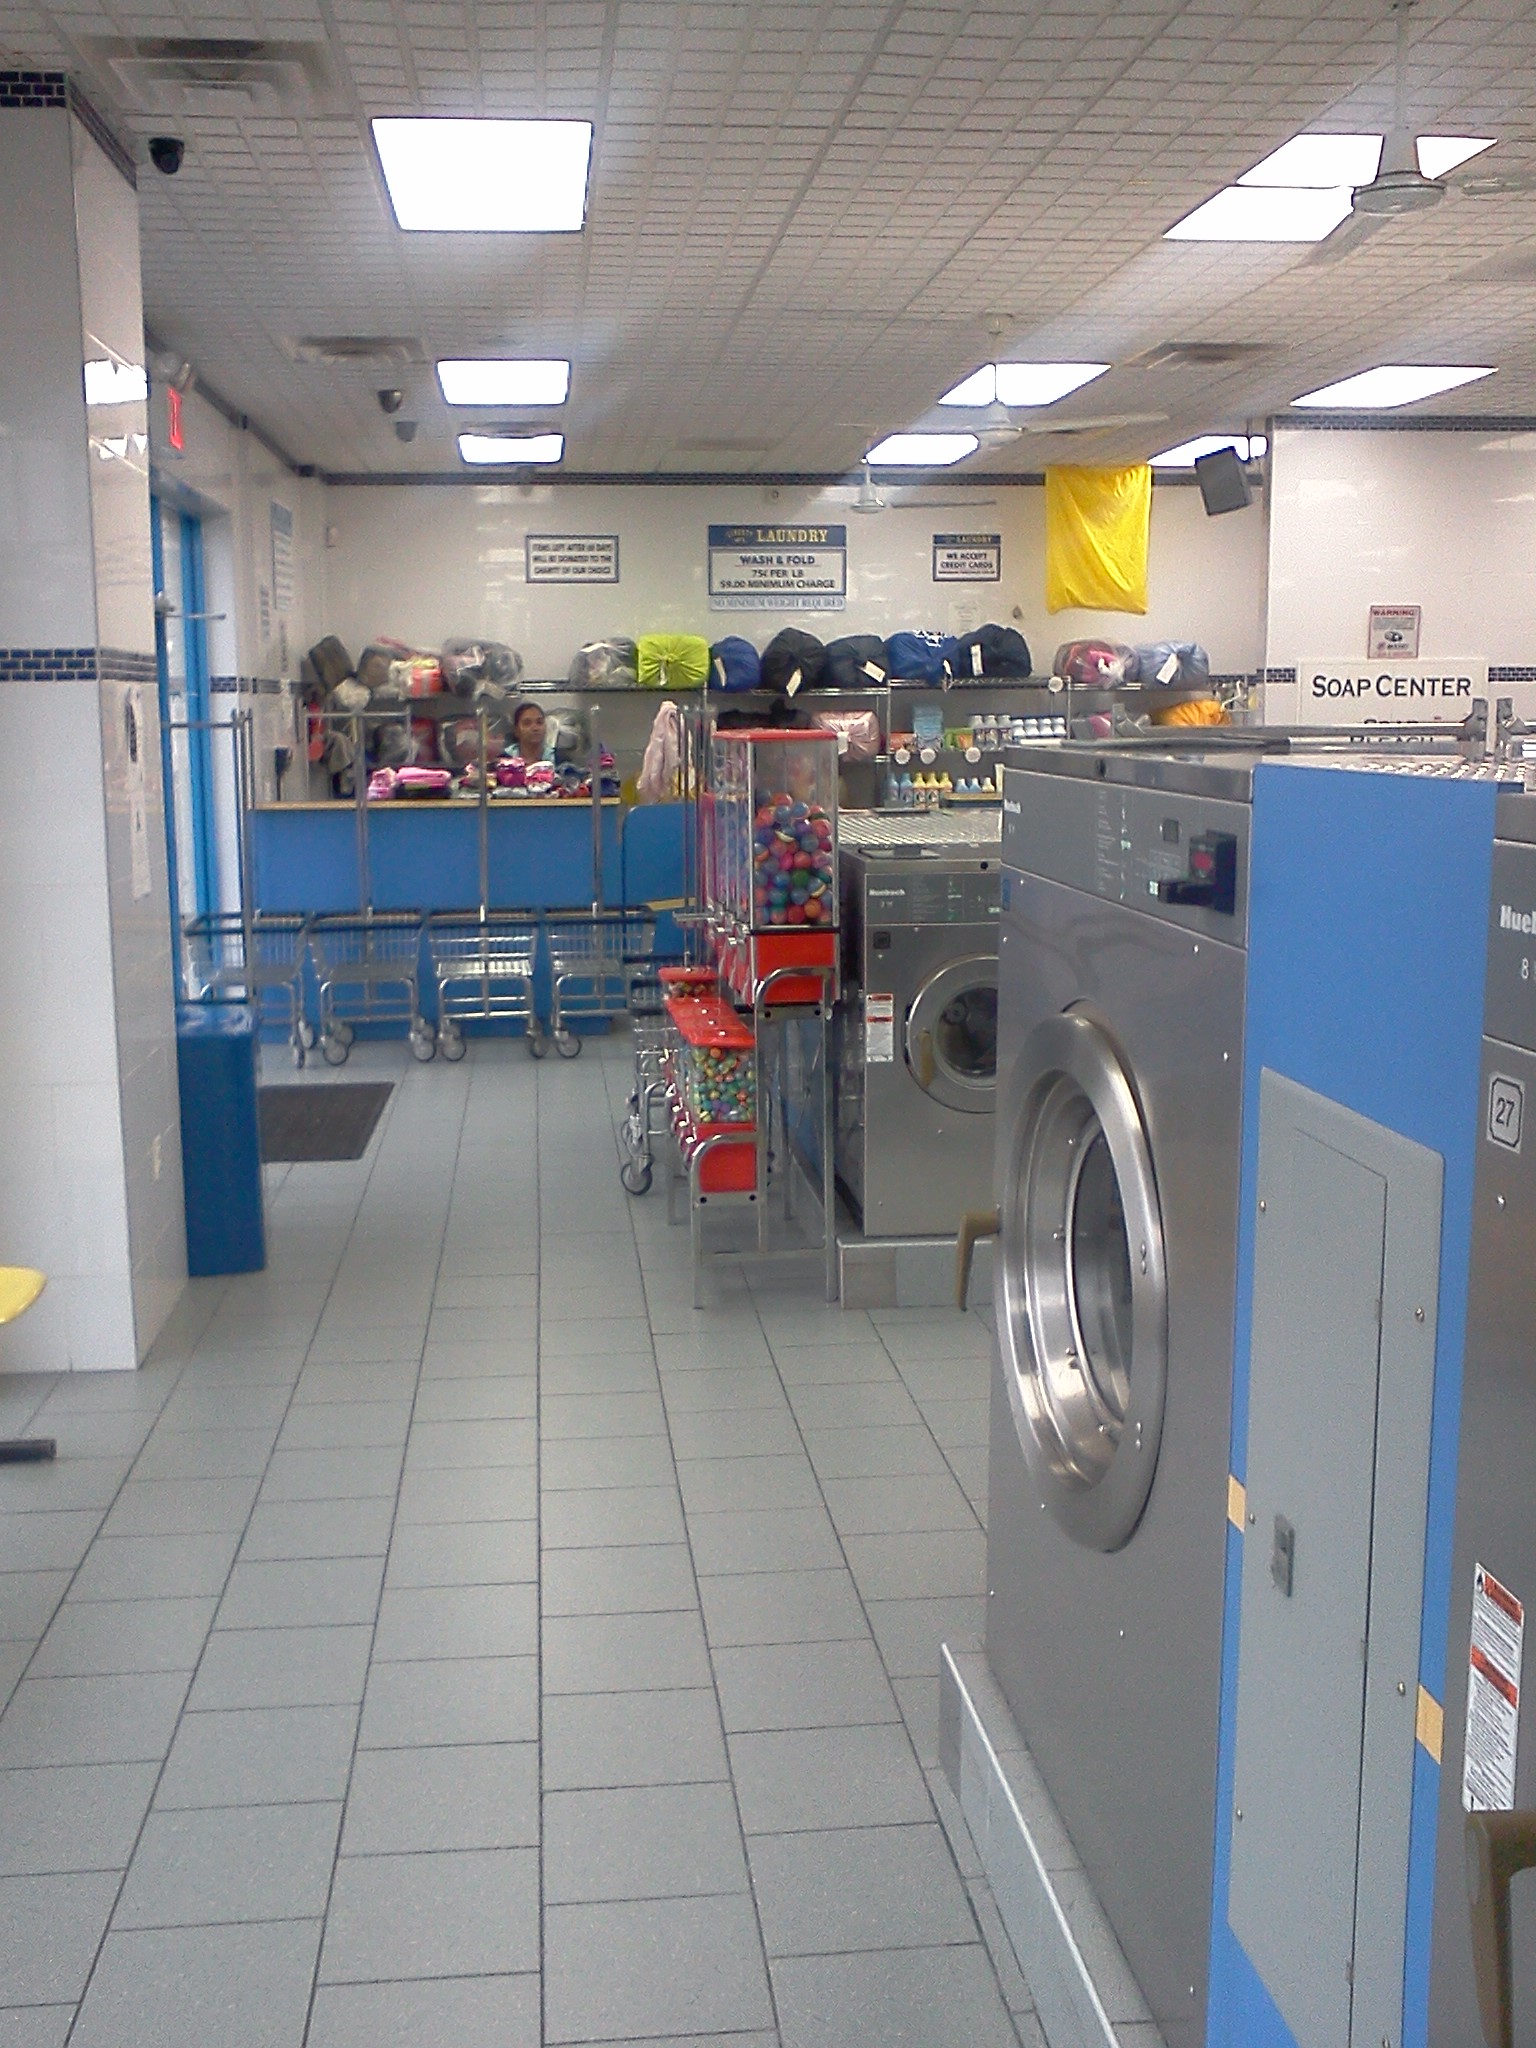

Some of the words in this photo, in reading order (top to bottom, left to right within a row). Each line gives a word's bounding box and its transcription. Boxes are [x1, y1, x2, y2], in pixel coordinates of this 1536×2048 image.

[756, 529, 828, 543] LAUNDRY
[740, 555, 773, 565] WASH
[776, 555, 783, 565] &
[786, 555, 815, 565] FOLD
[960, 552, 987, 560] ACCEPT
[941, 561, 966, 569] CREDIT
[968, 561, 993, 569] CARDS
[770, 569, 789, 578] PER
[792, 569, 805, 578] LB
[748, 580, 795, 589] MINIMUM
[796, 580, 836, 589] CHARGE
[1312, 675, 1371, 698] SOAP
[1375, 675, 1472, 697] CENTER
[1521, 957, 1529, 980] 8
[1495, 1097, 1515, 1128] 27
